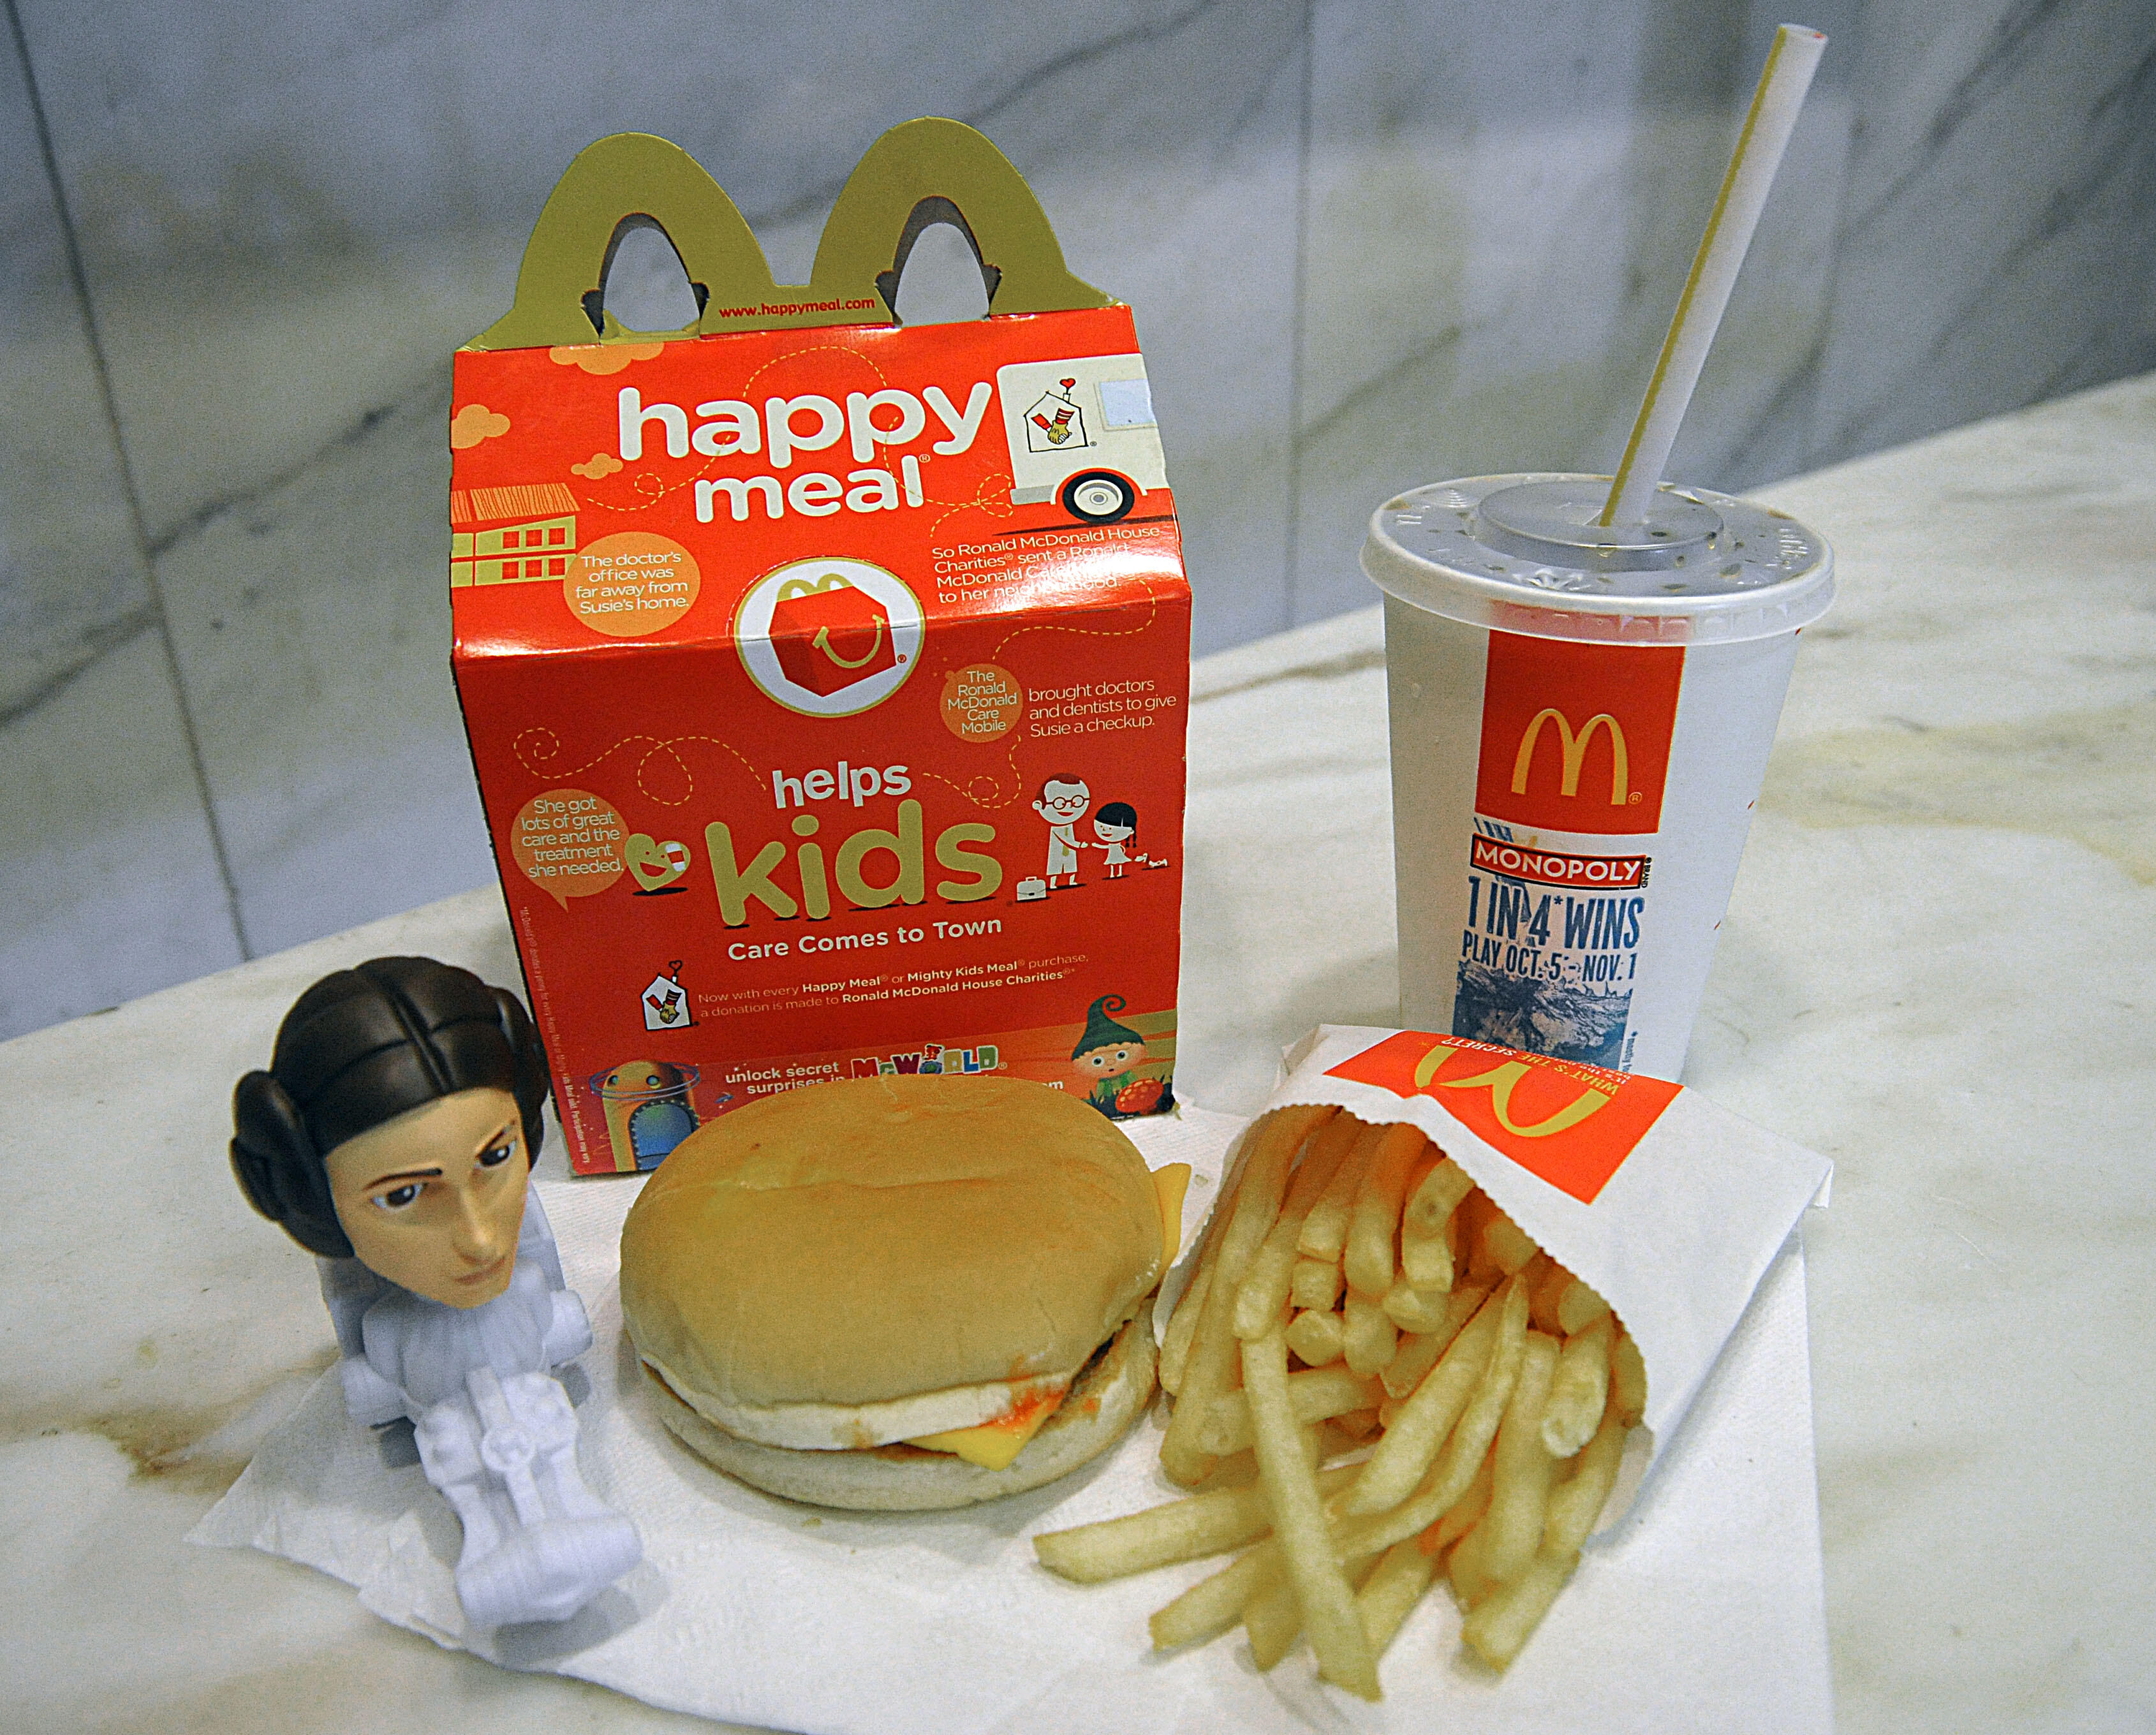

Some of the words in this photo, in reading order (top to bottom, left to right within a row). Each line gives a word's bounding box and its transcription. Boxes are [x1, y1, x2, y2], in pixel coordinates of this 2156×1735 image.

[719, 298, 876, 318] www.happymeal.com
[618, 381, 993, 469] happy
[932, 547, 956, 561] So
[958, 540, 1017, 557] Ronald
[1020, 529, 1105, 550] McDonald
[1107, 526, 1161, 540] House
[581, 555, 613, 568] The
[616, 551, 682, 566] doctor's
[1017, 549, 1053, 564] sent
[1057, 549, 1068, 560] a
[589, 568, 638, 583] office
[640, 568, 675, 579] was
[936, 568, 1023, 589] McDonald
[575, 586, 599, 599] far
[601, 584, 646, 598] away
[649, 580, 689, 594] from
[938, 591, 957, 604] to
[961, 586, 990, 602] her
[580, 598, 635, 615] Susie's
[637, 596, 690, 610] home.
[966, 670, 995, 684] The
[958, 680, 1007, 697] Ronald
[1029, 683, 1093, 702] brought
[1095, 679, 1155, 696] doctors
[948, 691, 1018, 711] McDonald
[1029, 703, 1060, 721] and
[1063, 699, 1123, 717] dentists
[1126, 697, 1142, 711] to
[1144, 693, 1178, 712] give
[967, 709, 1000, 721] Care
[961, 719, 1007, 734] Mobile
[1030, 721, 1072, 738] Susie
[1074, 722, 1084, 734] a
[1086, 714, 1156, 733] checkup.
[772, 760, 912, 809] helps
[534, 799, 566, 815] She
[568, 796, 598, 815] got
[521, 816, 550, 831] lots
[553, 813, 570, 829] of
[572, 811, 616, 830] great
[522, 834, 557, 847] care
[559, 829, 591, 845] and
[593, 827, 621, 841] the
[534, 843, 614, 862] treatment
[1475, 840, 1641, 882] MONOPOLY
[528, 864, 557, 878] she
[559, 858, 624, 875] needed.
[704, 799, 1003, 927] kids
[1468, 876, 1480, 928] 1
[1486, 881, 1521, 940] IN
[1564, 896, 1646, 950] WINS
[728, 941, 789, 962] Care
[798, 931, 889, 954] Comes
[897, 927, 925, 944] to
[933, 919, 1002, 940] Town
[1461, 929, 1503, 968] PLAY
[1548, 952, 1563, 980] 5
[1628, 952, 1638, 980] 1
[698, 993, 728, 1004] Now
[732, 989, 760, 1001] with
[763, 986, 800, 998] every
[802, 980, 846, 993] Happy
[892, 975, 904, 984] or
[907, 968, 952, 982] Mighty
[956, 964, 984, 977] Kids
[711, 1002, 770, 1017] donation
[772, 1002, 783, 1011] is
[785, 997, 822, 1009] made
[825, 996, 839, 1006] to
[842, 989, 889, 1003] Ronald
[892, 982, 959, 998] McDonald
[962, 978, 1003, 991] House
[1441, 1037, 1517, 1056] SECRET?
[1517, 1054, 1551, 1067] THE
[725, 1067, 781, 1084] unlock
[786, 1061, 840, 1077] secret
[1554, 1065, 1620, 1096] WHAT'S
[747, 1077, 825, 1095] surprises
